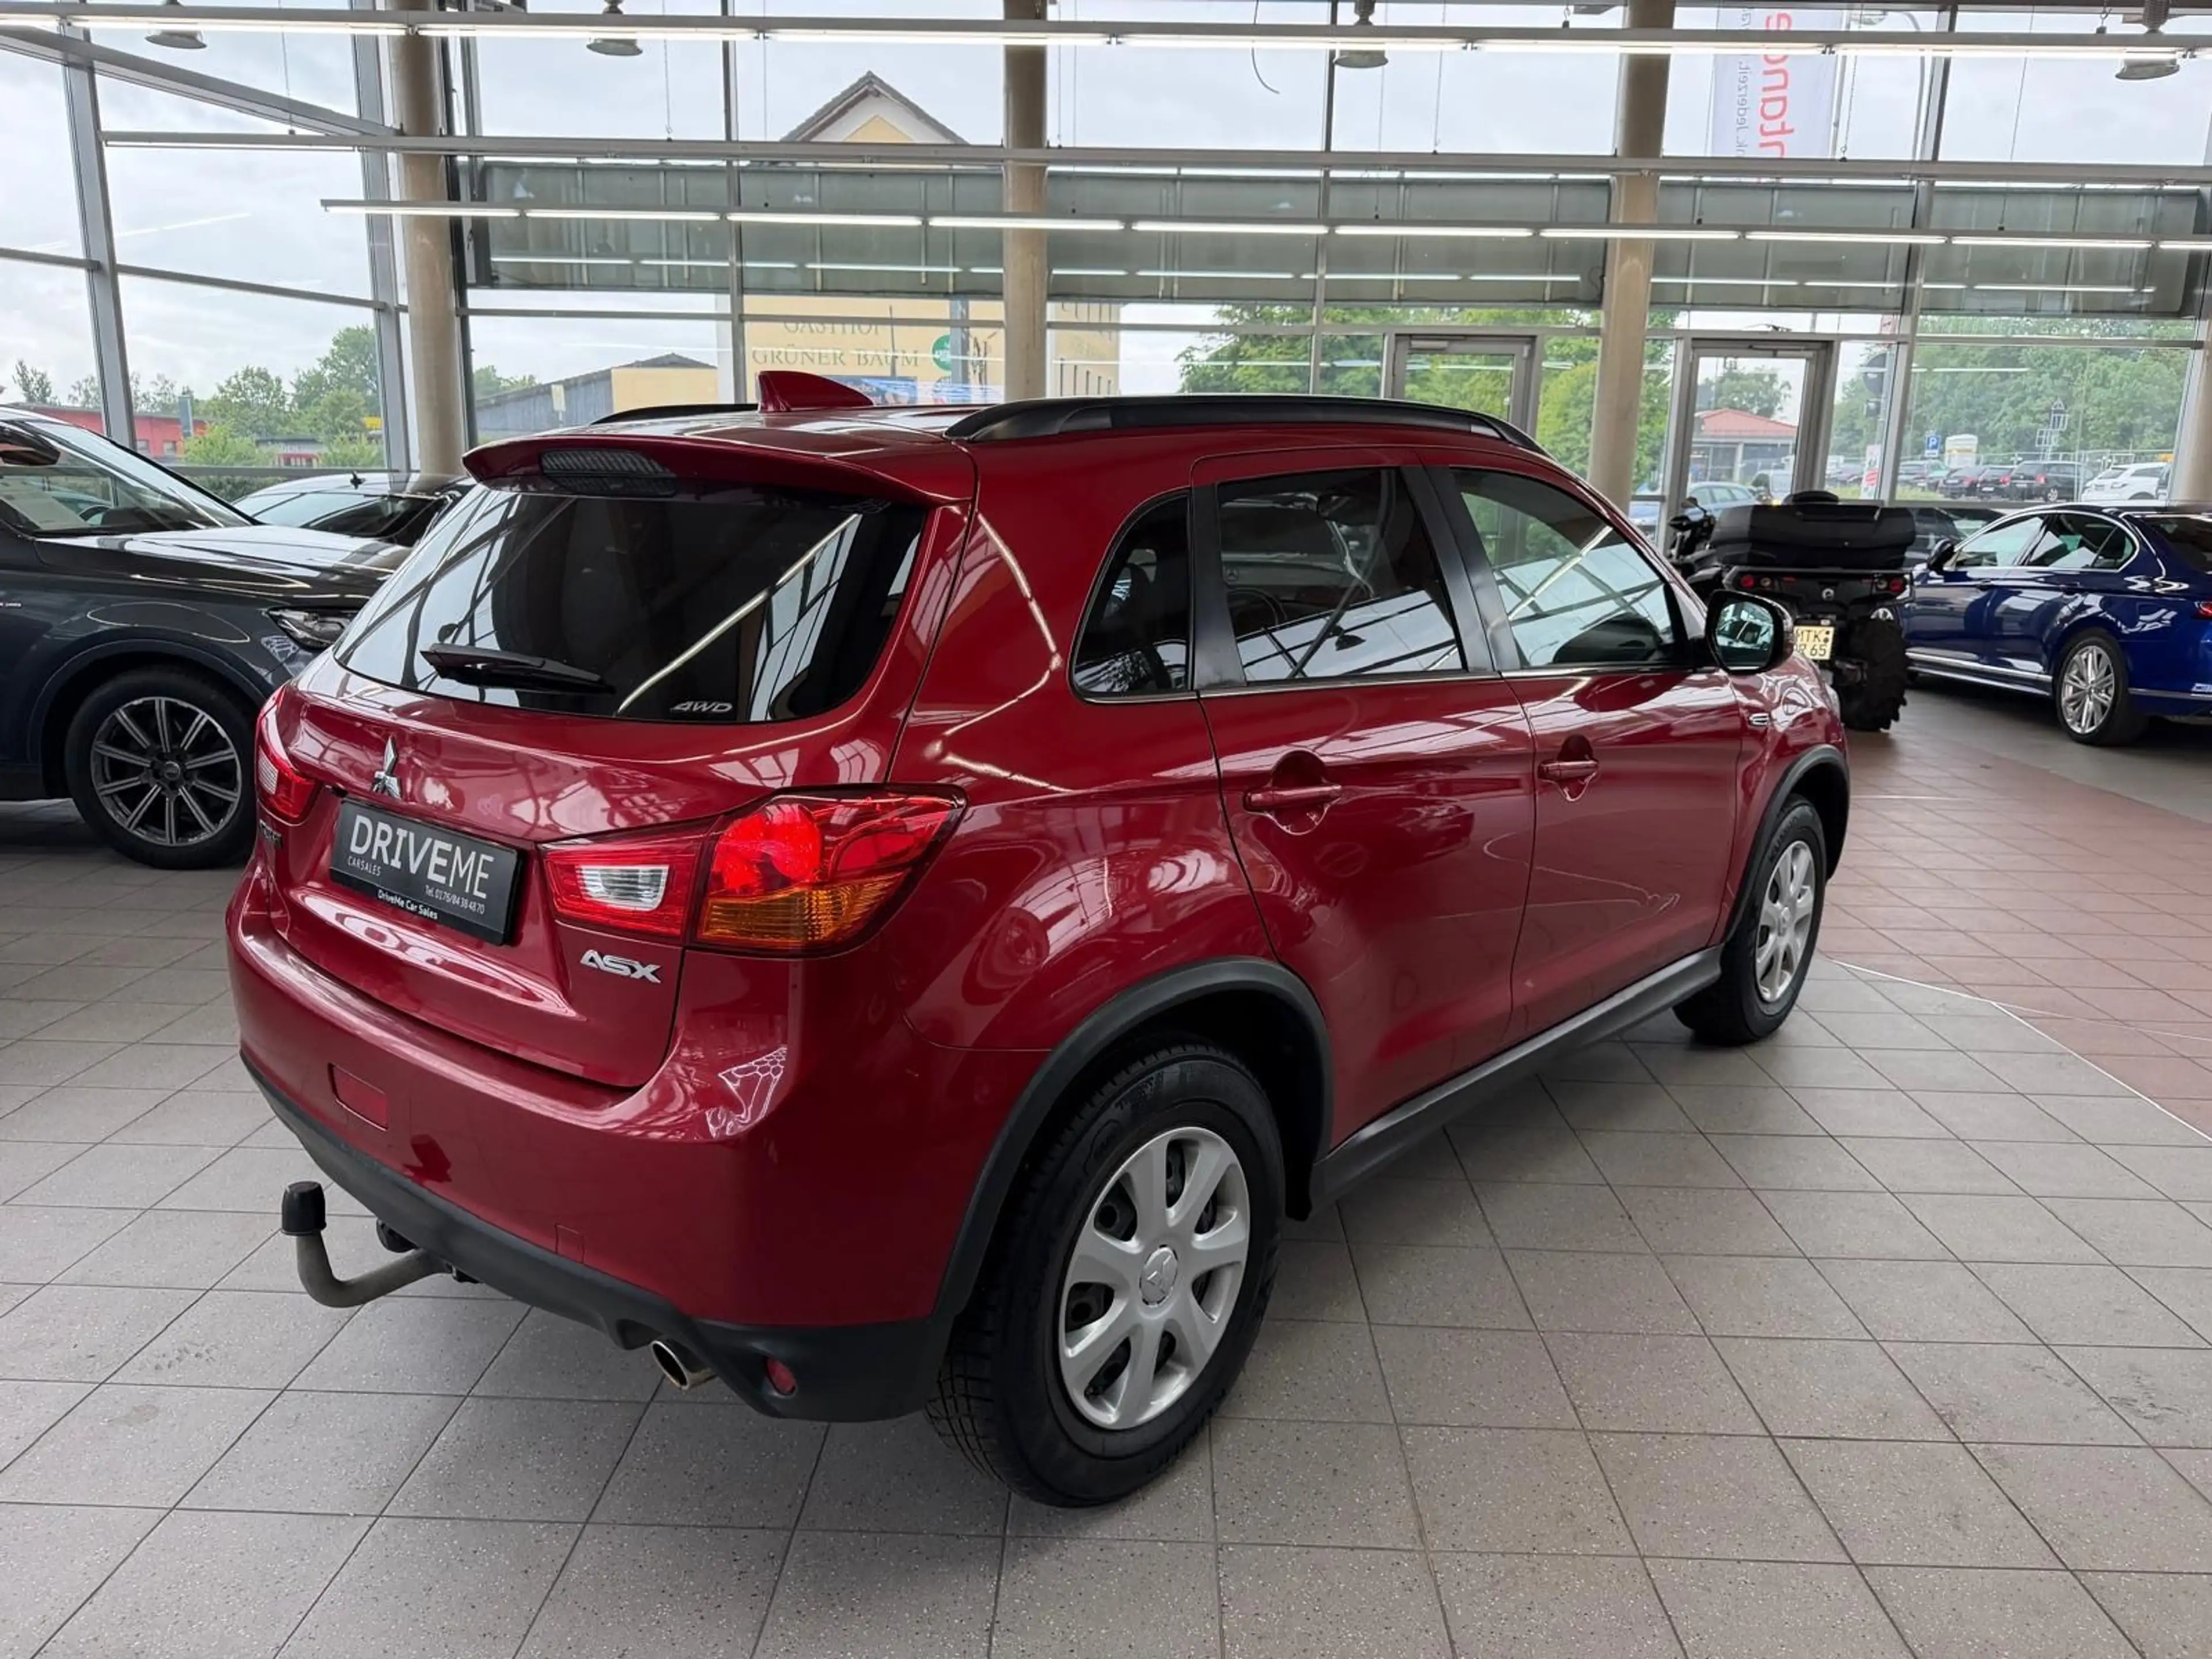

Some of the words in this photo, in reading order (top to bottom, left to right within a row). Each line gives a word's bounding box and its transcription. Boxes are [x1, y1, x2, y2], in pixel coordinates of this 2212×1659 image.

[752, 343, 846, 366] GRÜNER
[856, 349, 919, 366] BAUM
[1810, 644, 1827, 656] 65
[669, 700, 733, 713] 4WD
[348, 855, 381, 876] CARSALES
[350, 814, 495, 899] DRIVEME
[377, 889, 405, 908] DriveMe
[406, 900, 418, 911] Car
[418, 904, 438, 920] Sales
[580, 949, 662, 984] ASX
